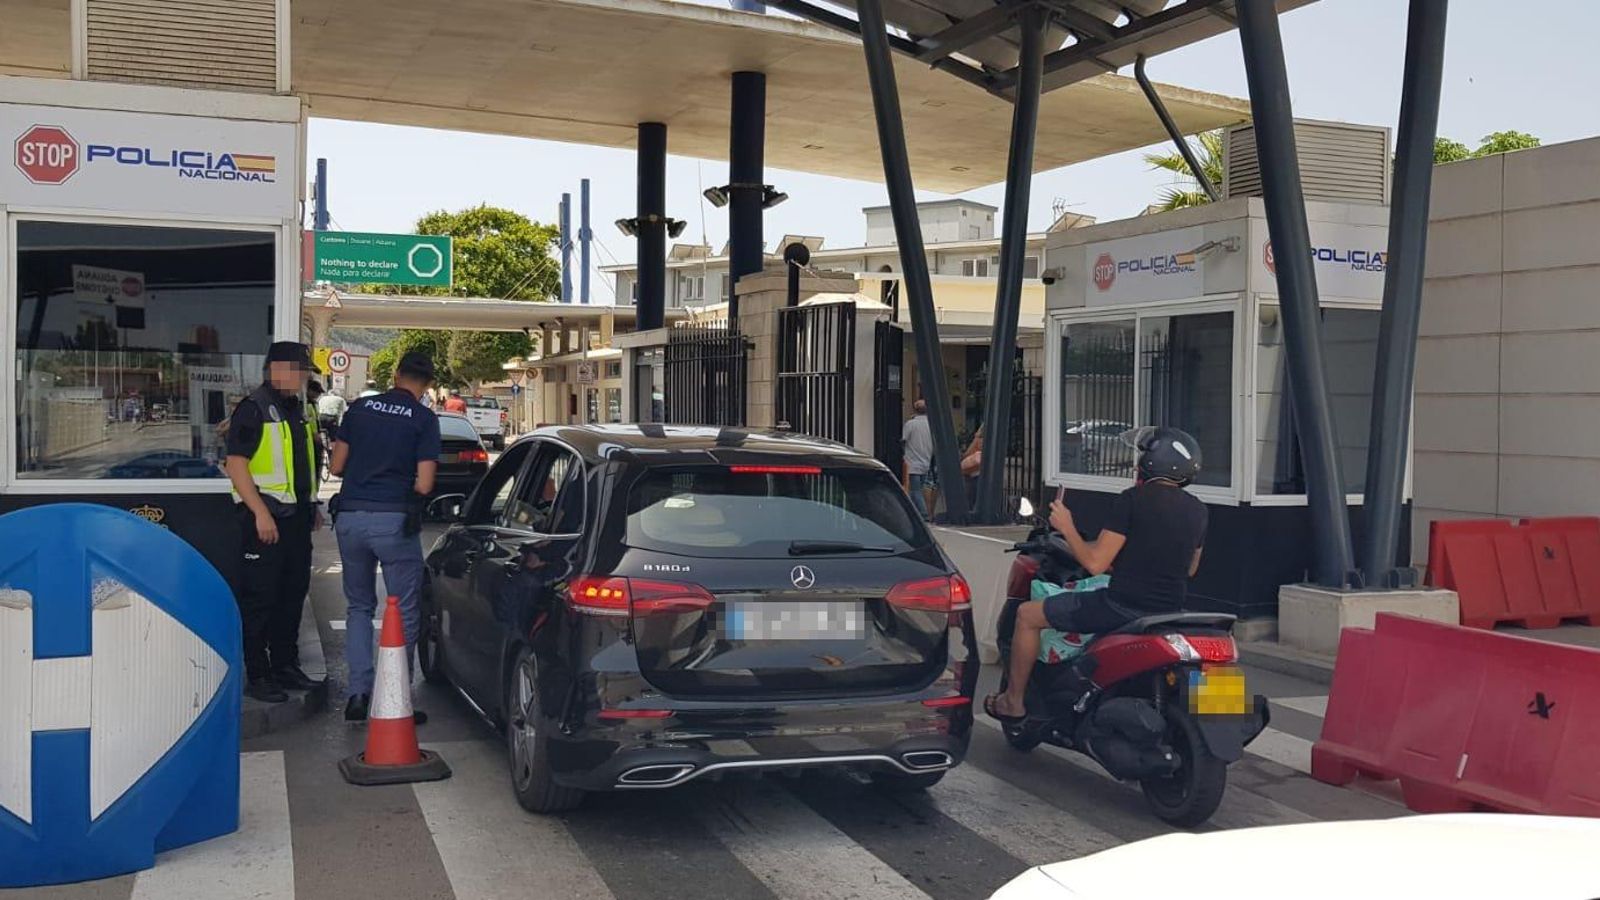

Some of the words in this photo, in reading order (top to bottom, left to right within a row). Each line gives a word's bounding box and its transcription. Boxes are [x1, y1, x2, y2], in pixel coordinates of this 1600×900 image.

[22, 141, 72, 168] STOP
[179, 168, 275, 182] NACIONAL
[321, 258, 355, 268] Nothing
[357, 259, 367, 267] to
[368, 259, 399, 270] declare
[1153, 265, 1195, 276] NACIONAL
[320, 267, 341, 276] Nada
[342, 269, 360, 278] para
[1095, 264, 1114, 281] STOP
[332, 356, 346, 367] 10
[364, 399, 413, 418] POLIZIA
